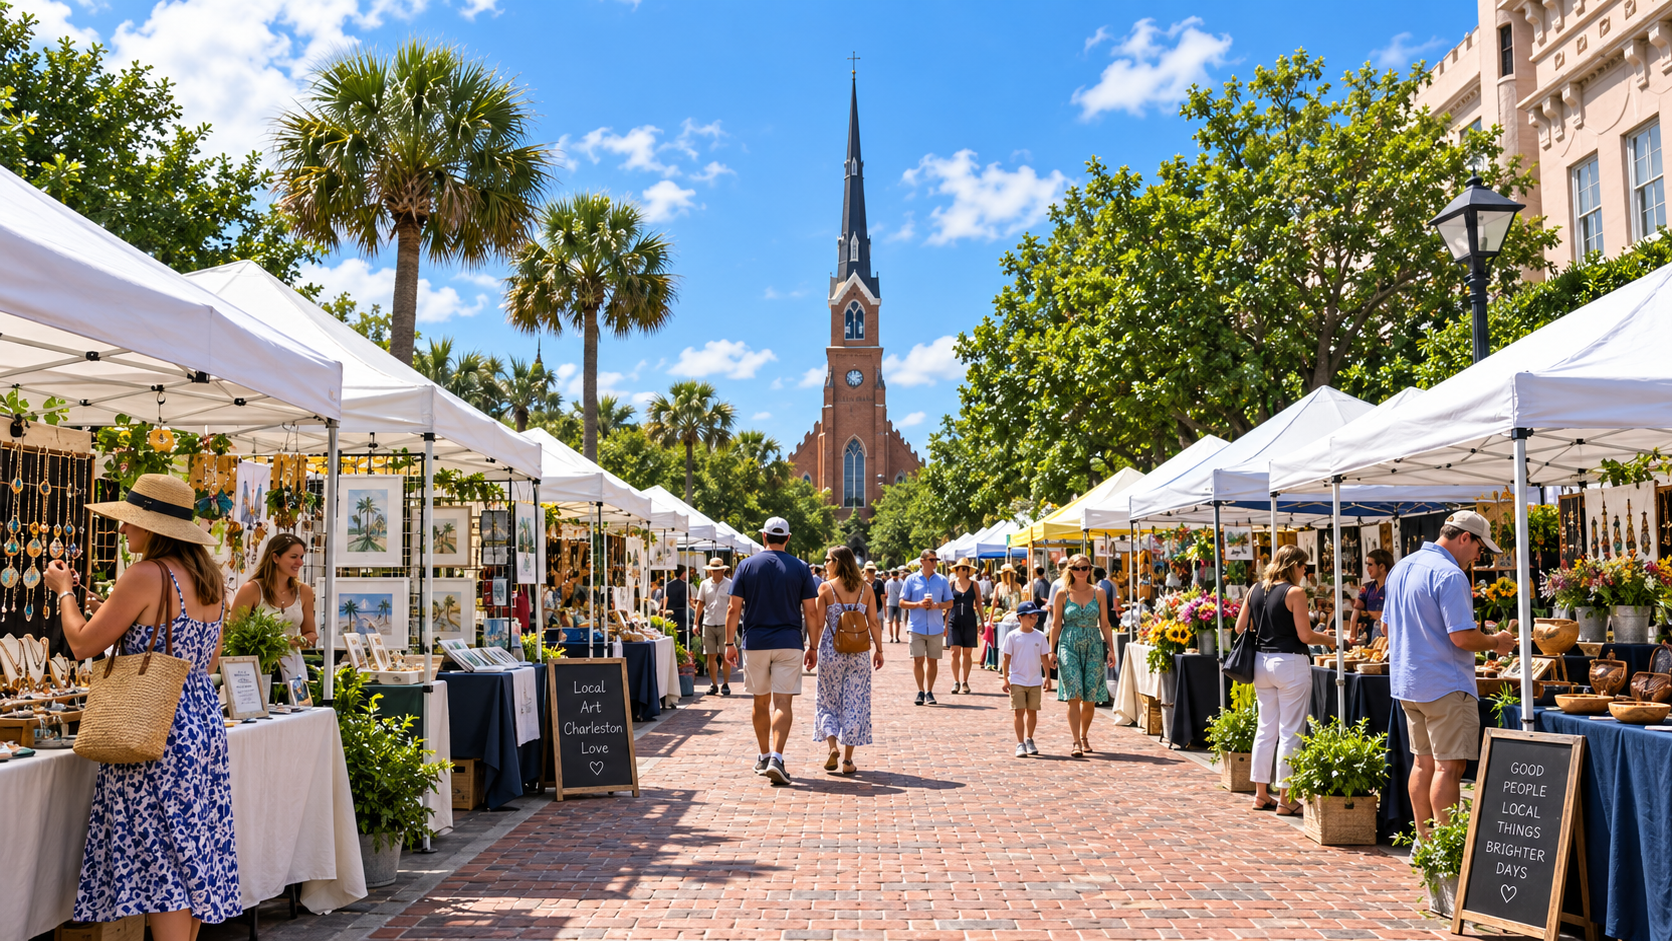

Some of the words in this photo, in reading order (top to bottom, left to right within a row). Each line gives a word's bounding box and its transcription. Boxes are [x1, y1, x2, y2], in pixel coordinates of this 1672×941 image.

[573, 680, 606, 694] Local
[580, 700, 602, 714] Art
[564, 721, 623, 735] Charleston
[581, 741, 609, 755] Love
[1511, 762, 1544, 776] GOOD
[1503, 781, 1547, 797] PEOPLE
[1502, 802, 1540, 818] LOCAL
[1498, 821, 1541, 838] THINGS
[1485, 841, 1546, 862] BRIGHTER
[1495, 862, 1528, 879] DAYS
